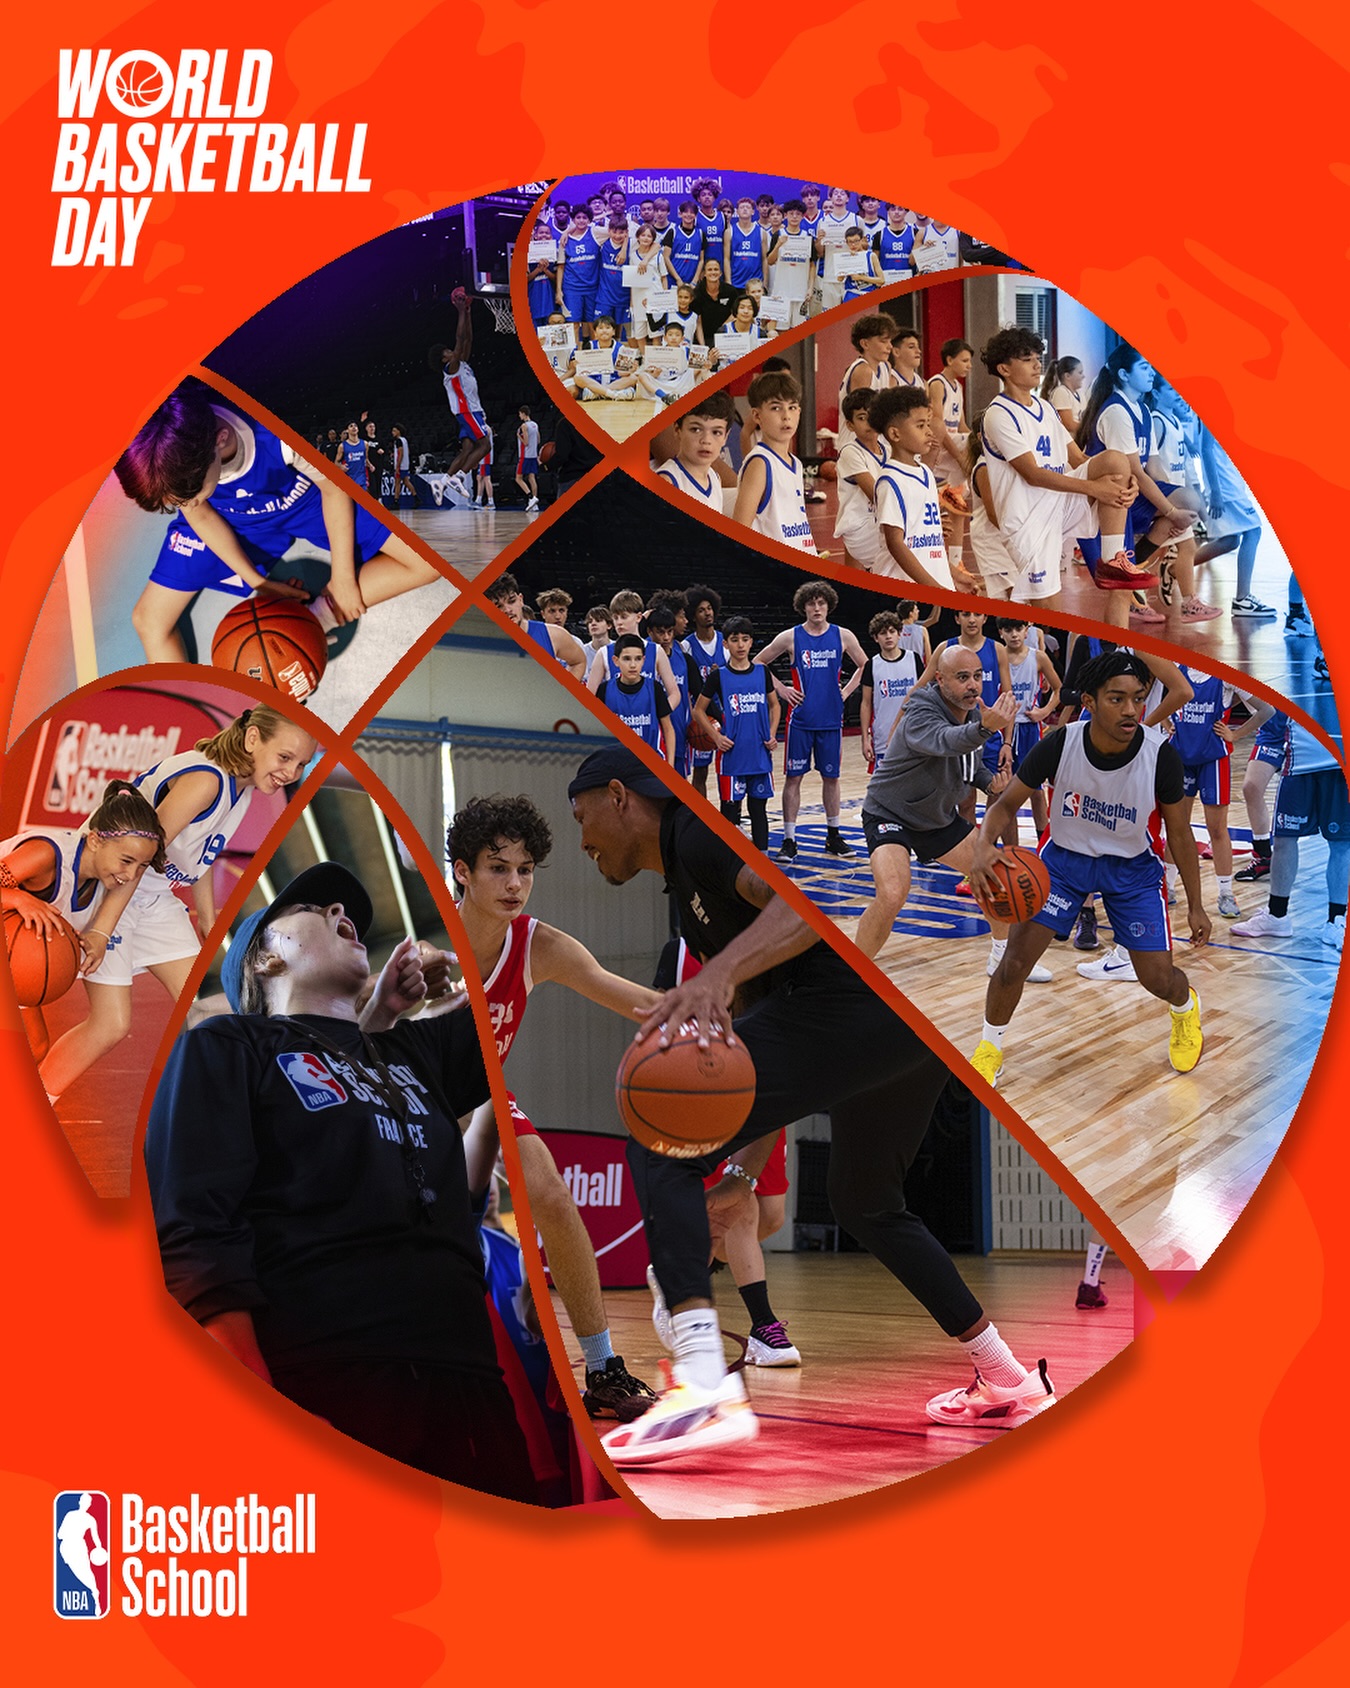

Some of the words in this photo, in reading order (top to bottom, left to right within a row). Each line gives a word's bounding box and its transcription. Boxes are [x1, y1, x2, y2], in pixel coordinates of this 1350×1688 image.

[627, 175, 683, 194] Basketball
[923, 502, 941, 526] 32
[738, 692, 765, 705] Basketball
[739, 701, 758, 714] School
[1183, 701, 1215, 714] Basketball
[1183, 712, 1206, 724] School
[81, 723, 182, 773] Basketball
[1081, 807, 1117, 832] School
[1083, 795, 1138, 824] Basketball
[196, 833, 227, 866] 19
[308, 1090, 333, 1107] NBA
[374, 1113, 429, 1149] FRACE
